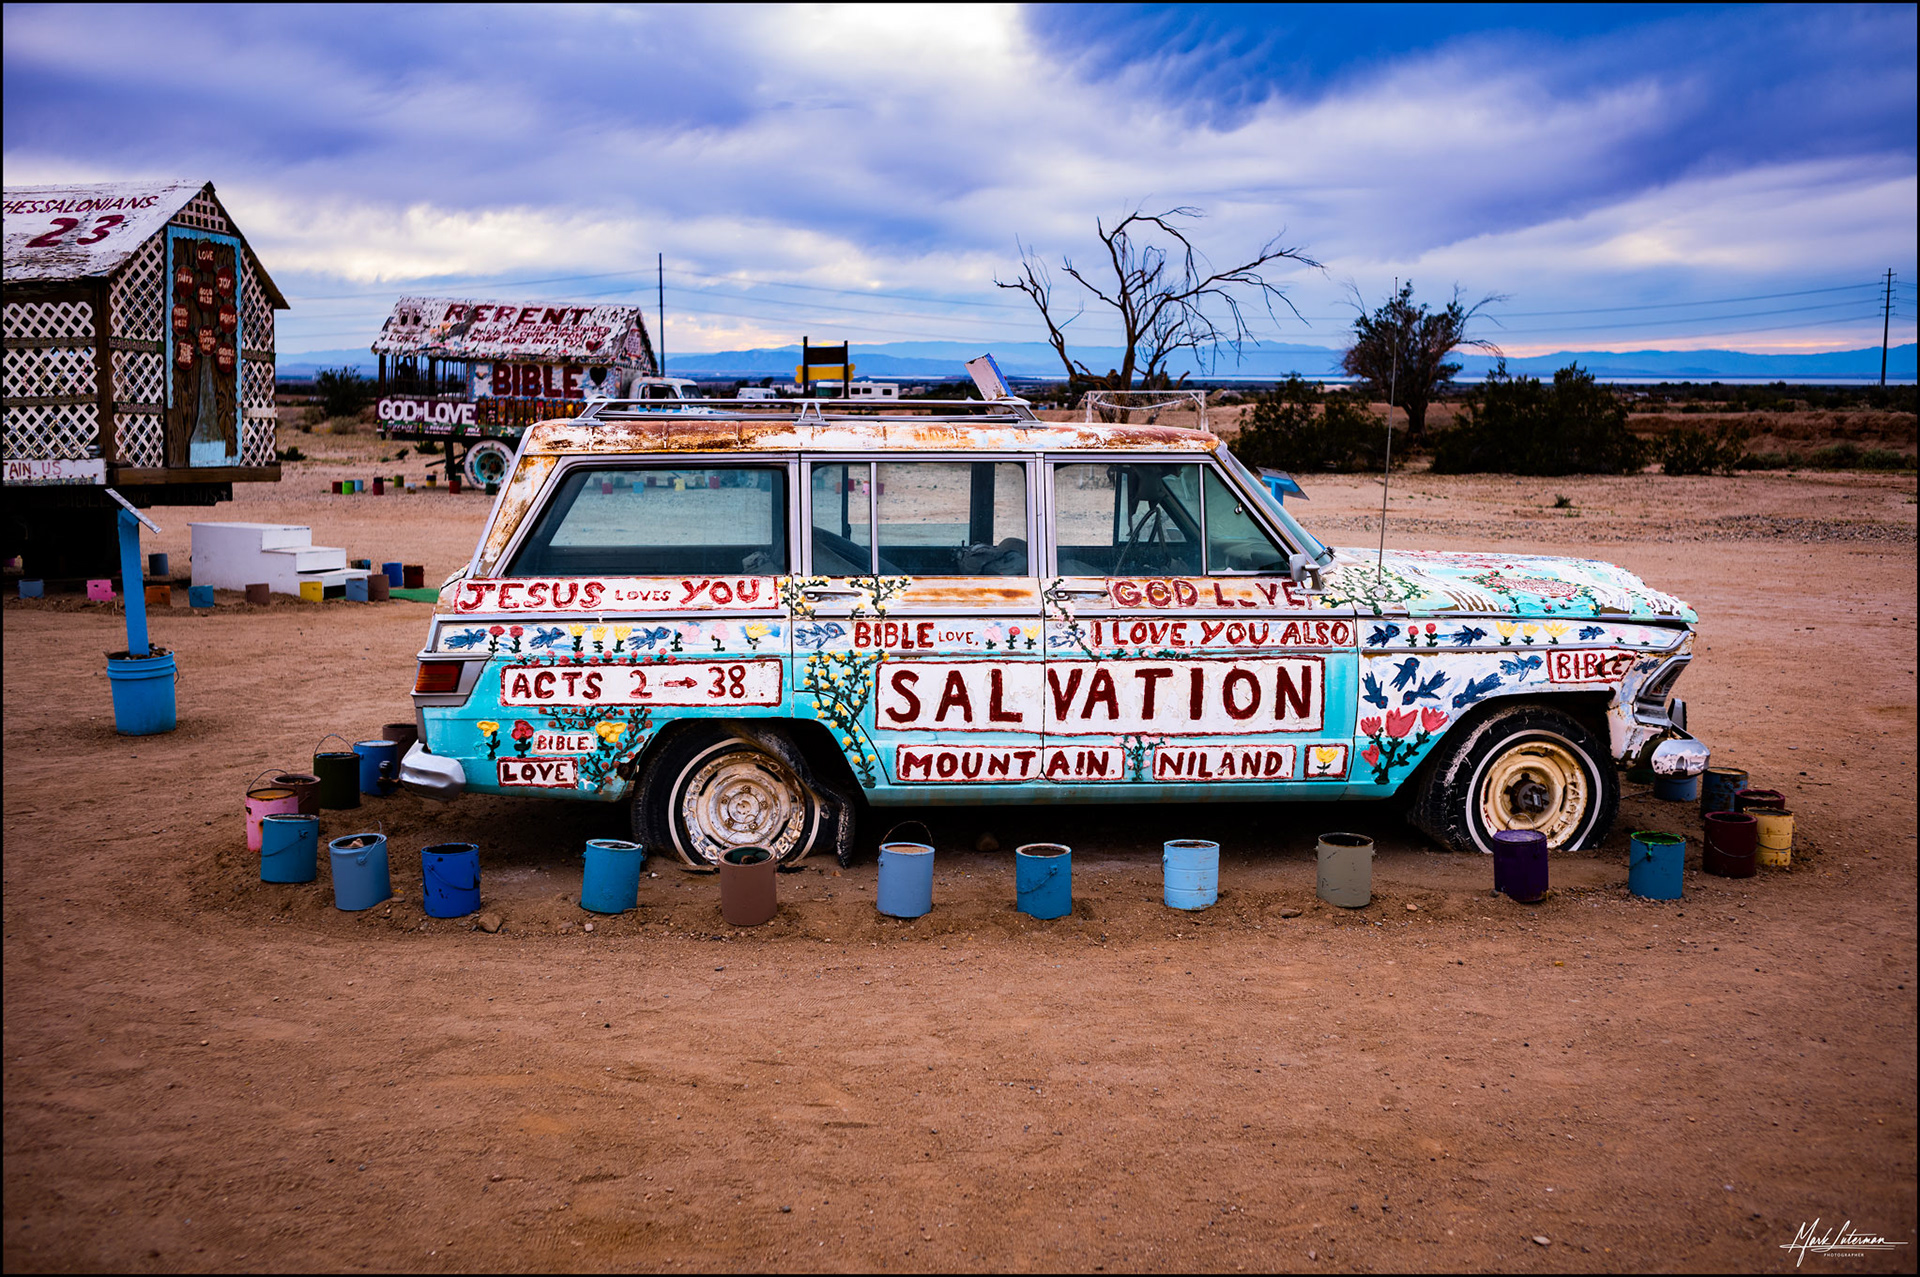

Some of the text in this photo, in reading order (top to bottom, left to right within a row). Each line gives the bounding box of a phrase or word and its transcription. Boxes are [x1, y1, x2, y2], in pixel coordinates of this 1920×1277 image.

[198, 250, 214, 261] LOVE
[219, 277, 231, 289] JOY
[492, 363, 584, 399] BIBLE
[379, 399, 417, 421] GOD
[424, 400, 476, 425] LOVE
[41, 460, 62, 475] US
[458, 581, 606, 610] JESUS
[615, 588, 671, 602] LOVES
[1111, 579, 1307, 608] GOD LVE
[854, 621, 935, 649] BIBLE
[1094, 621, 1103, 646] I
[1556, 652, 1633, 679] BIBLE
[511, 670, 602, 700] ACTS
[630, 669, 652, 699] 2
[885, 664, 1312, 723] SALVATION
[502, 762, 568, 784] LOVE
